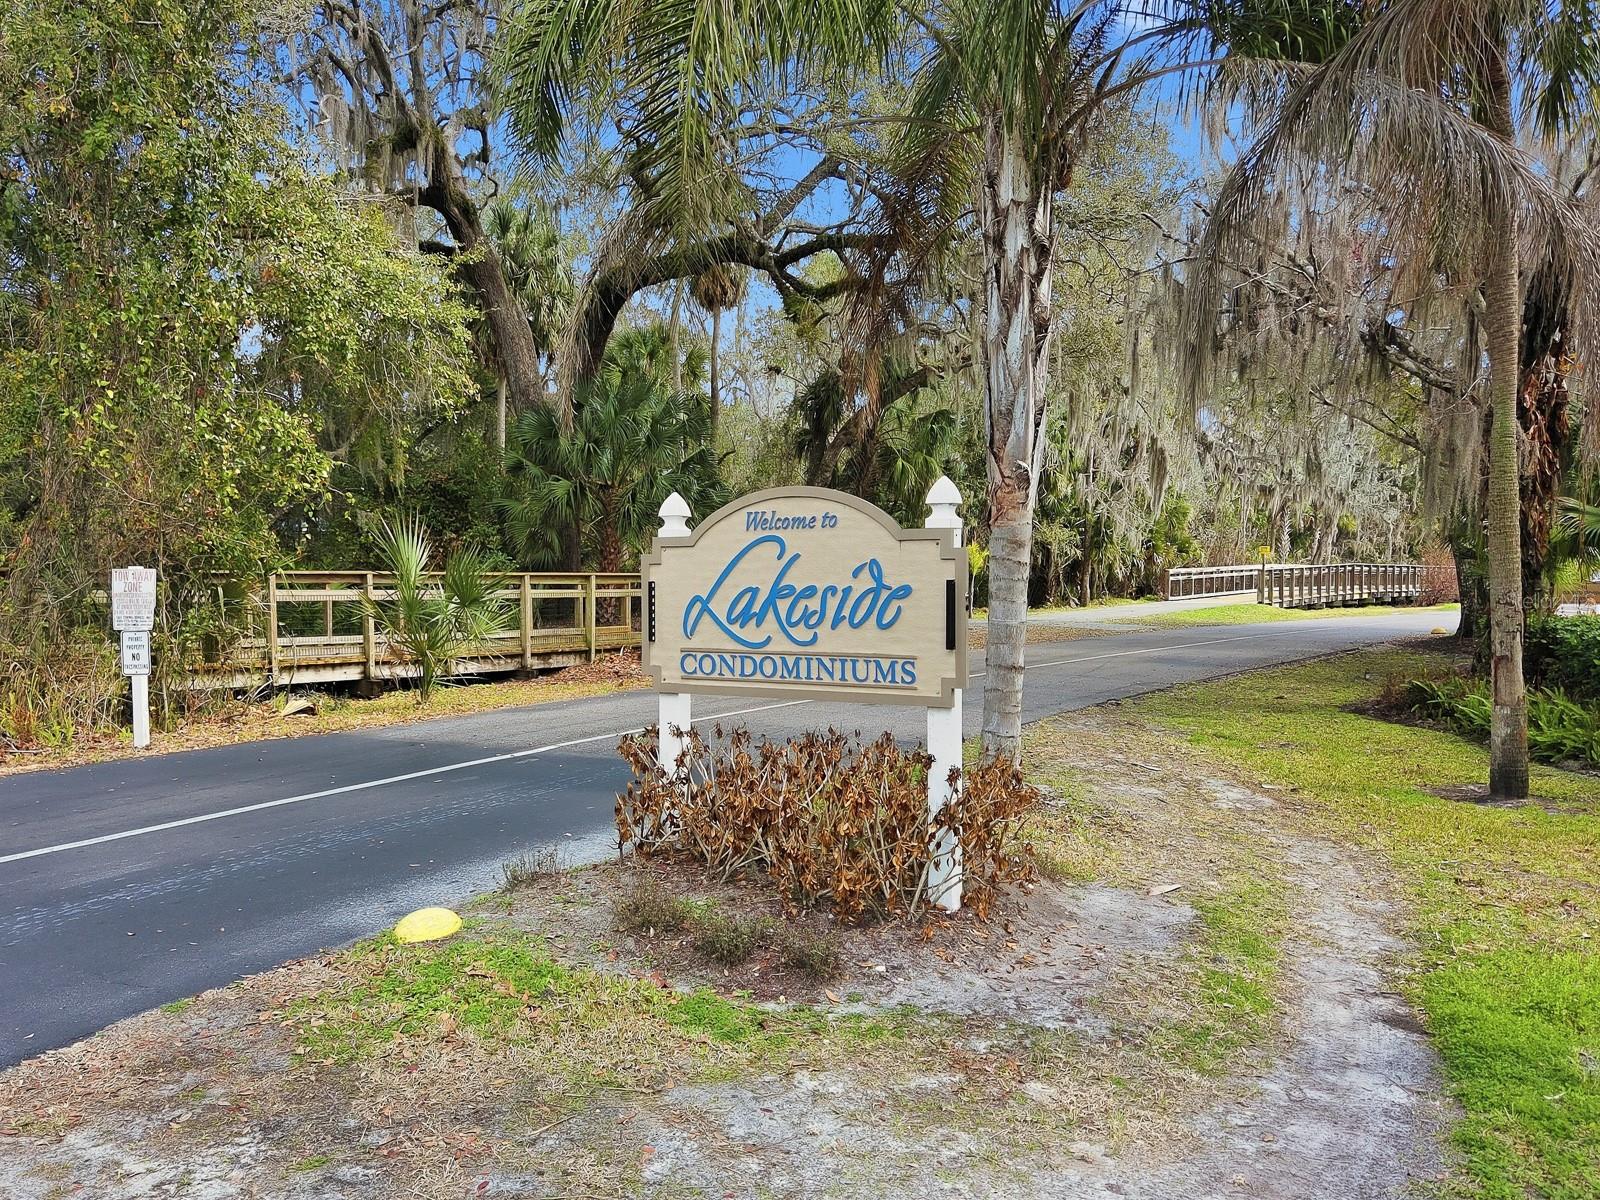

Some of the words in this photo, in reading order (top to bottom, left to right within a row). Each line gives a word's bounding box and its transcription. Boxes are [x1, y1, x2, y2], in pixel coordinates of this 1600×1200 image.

[745, 510, 817, 532] Welcome
[820, 511, 838, 529] to
[114, 570, 129, 582] TOW
[132, 570, 154, 582] AWAY
[123, 581, 143, 593] ZONE
[683, 534, 913, 649] Lakeside
[131, 652, 141, 661] NO
[680, 652, 917, 685] CONDOMINIUMS
